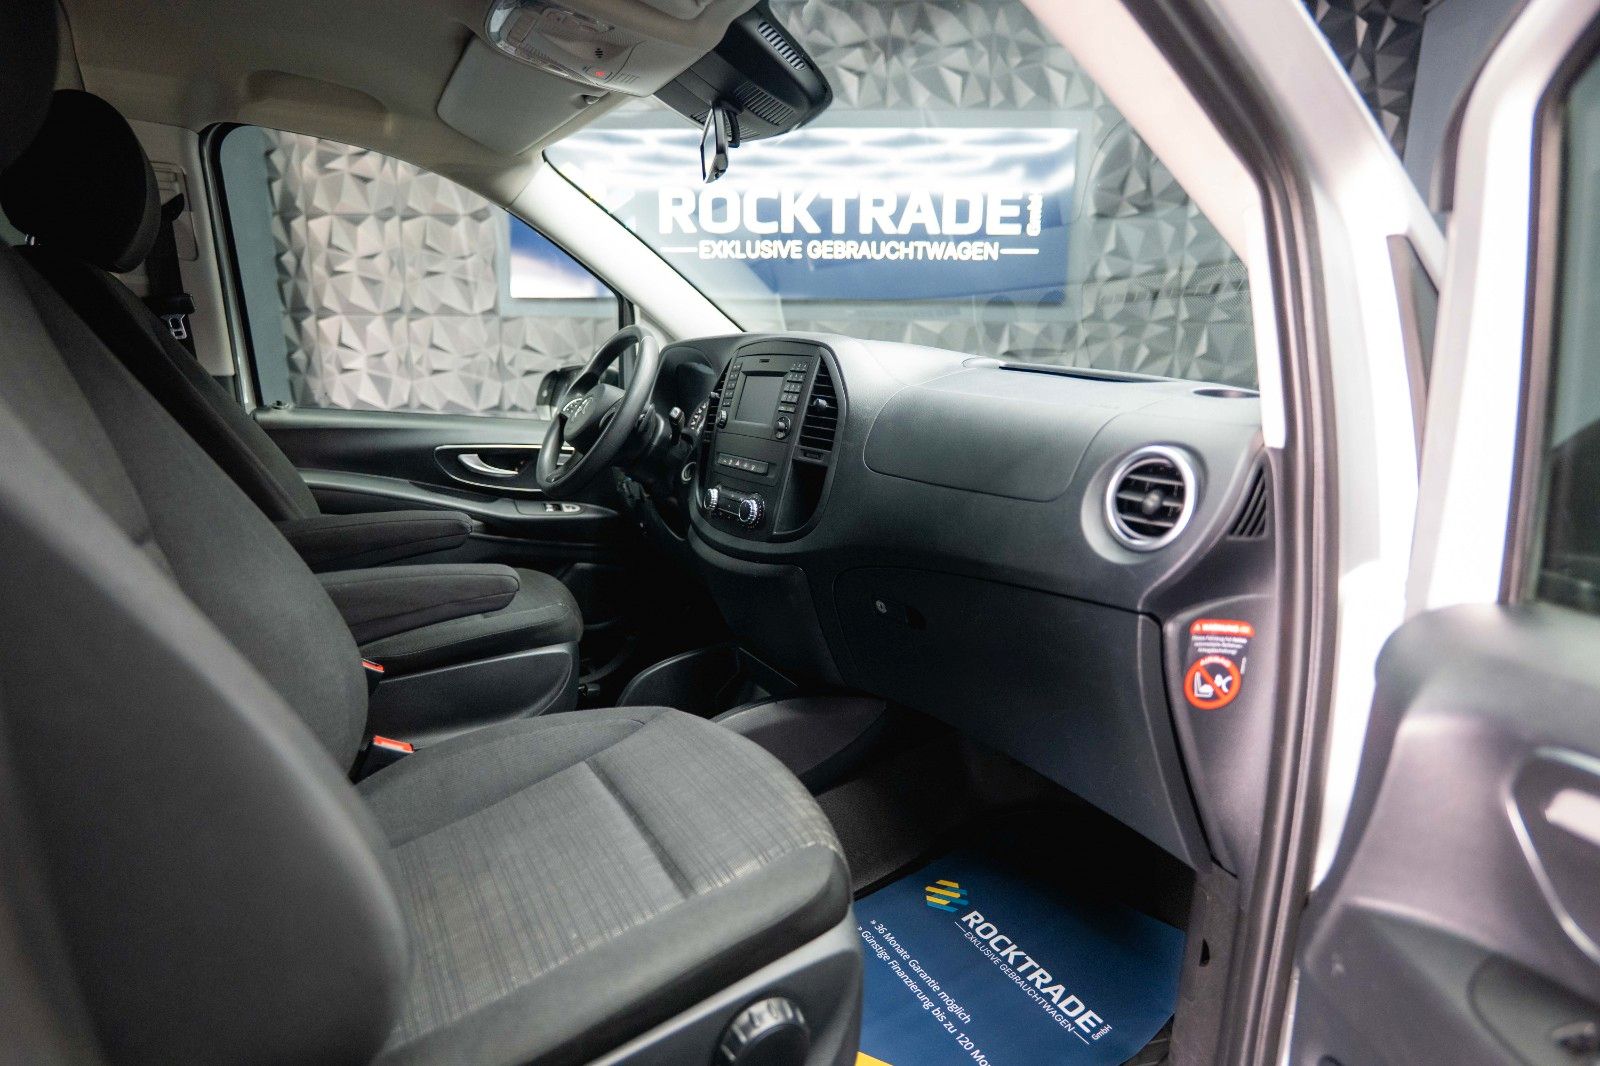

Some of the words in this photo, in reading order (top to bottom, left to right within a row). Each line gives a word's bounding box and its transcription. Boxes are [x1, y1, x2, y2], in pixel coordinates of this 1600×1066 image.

[658, 189, 1022, 236] ROCKTRADE
[699, 239, 803, 260] EXKLUSIVE
[807, 239, 1000, 261] GEBRAUCHTWAGEN
[861, 930, 891, 961] Günstige
[888, 960, 935, 1010] Finanzierung
[932, 1006, 947, 1022] bis
[943, 1021, 957, 1034] zu
[956, 1032, 975, 1051] 120
[874, 923, 887, 934] 36
[883, 932, 911, 960] Monate
[908, 959, 941, 992] Garantie
[937, 991, 972, 1025] möglich
[961, 910, 1104, 1034] ROCKTRADE
[964, 931, 1002, 966] EXKLUSIVE
[1000, 963, 1075, 1033] GEBRAUCHTWAGEN
